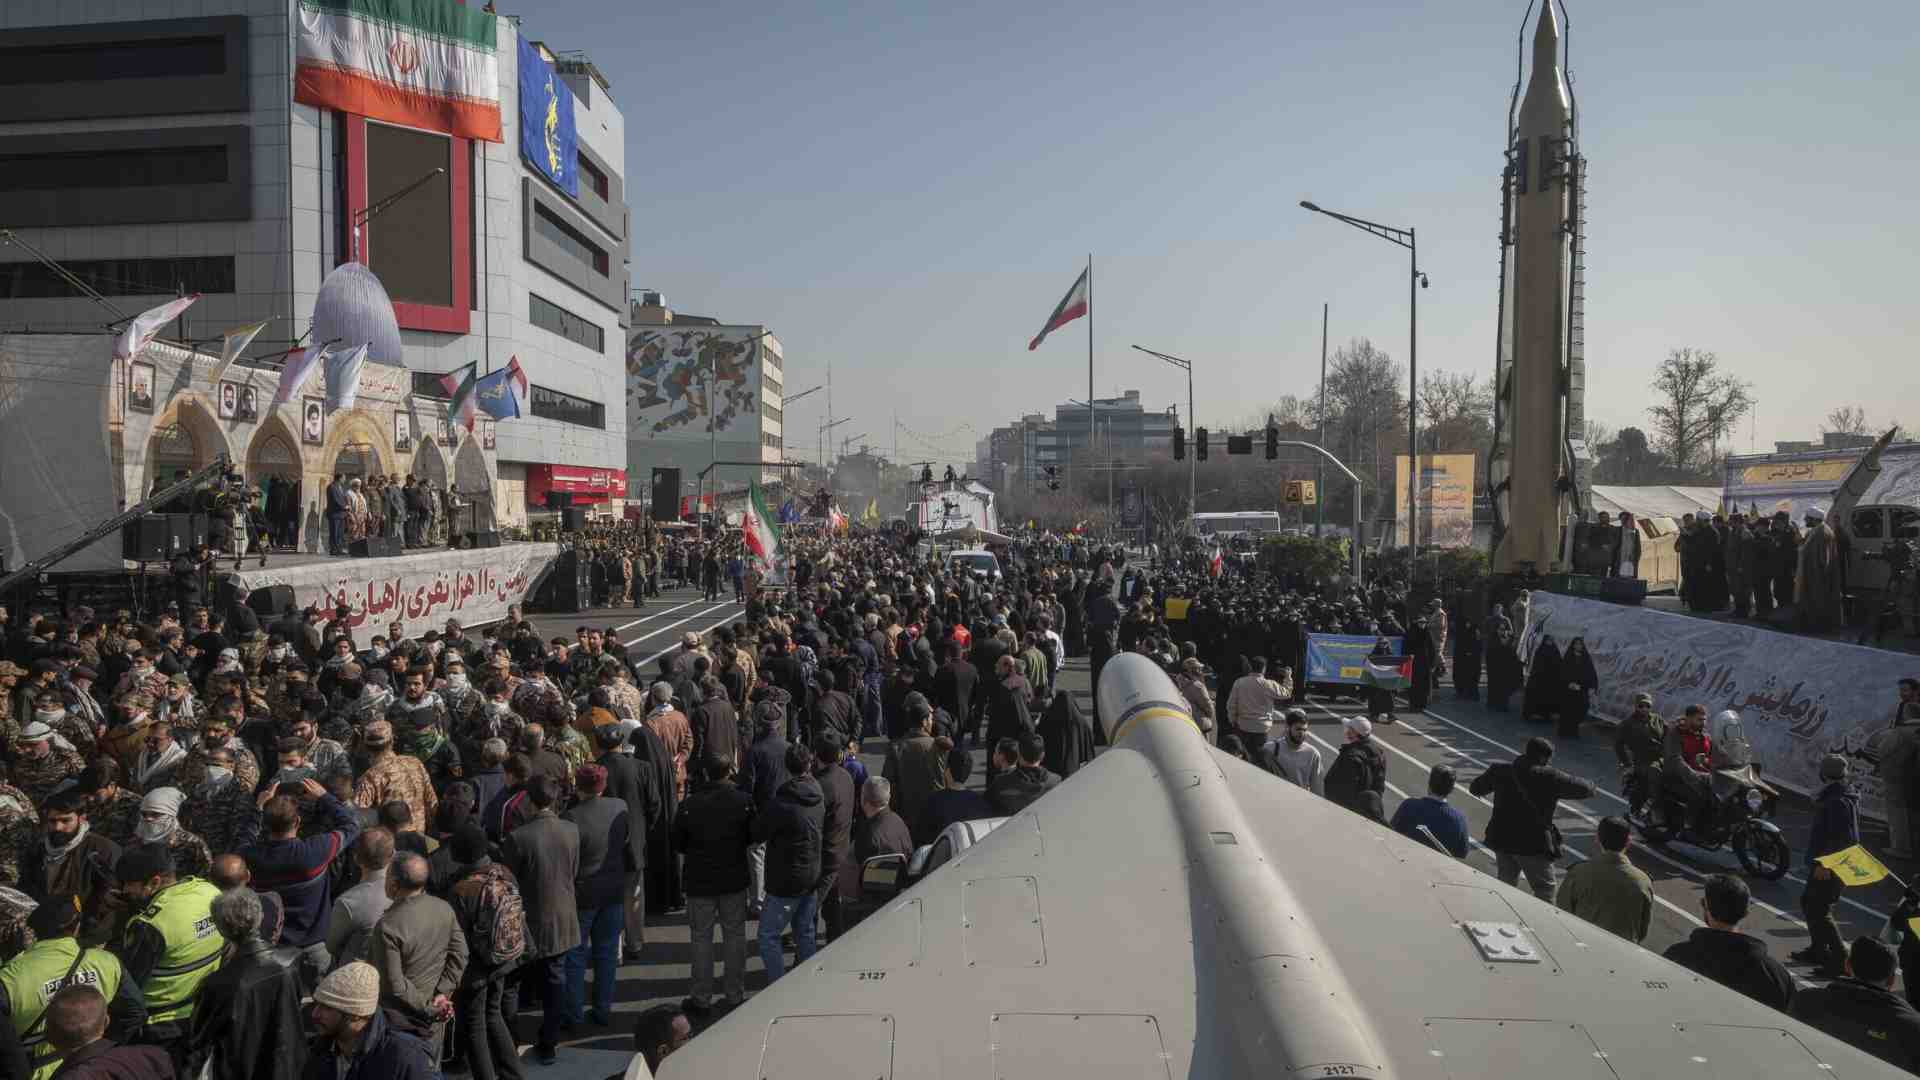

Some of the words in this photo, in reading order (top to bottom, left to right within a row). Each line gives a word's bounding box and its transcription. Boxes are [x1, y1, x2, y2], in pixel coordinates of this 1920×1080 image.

[346, 577, 405, 627] راهیان
[408, 572, 450, 620] نفری
[451, 570, 474, 612] هزار
[1726, 675, 1827, 736] رزمایش
[858, 971, 886, 981] 2127
[1323, 1064, 1355, 1076] 2127
